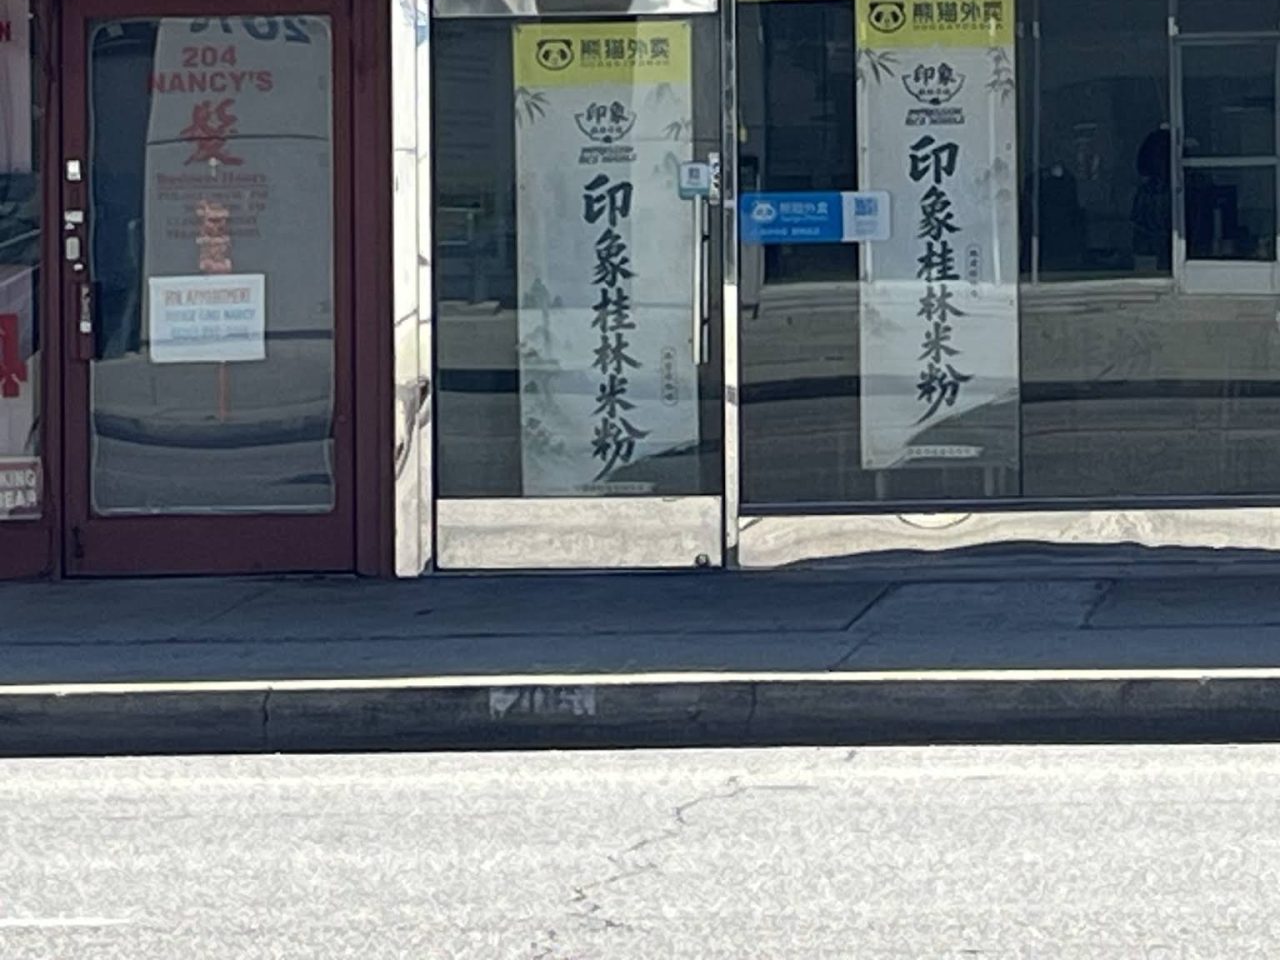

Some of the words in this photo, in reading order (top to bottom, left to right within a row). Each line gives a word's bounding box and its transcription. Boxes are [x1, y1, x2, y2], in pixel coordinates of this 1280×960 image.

[912, 0, 1003, 23] 熊猫外卖
[181, 45, 237, 69] 204
[580, 37, 670, 60] 熊猫外卖
[147, 70, 274, 94] NANCY'S
[913, 62, 956, 87] 印象
[586, 101, 629, 124] 印象
[906, 134, 973, 425] 印象桂林米粉
[582, 173, 653, 484] 印象桂林米粉
